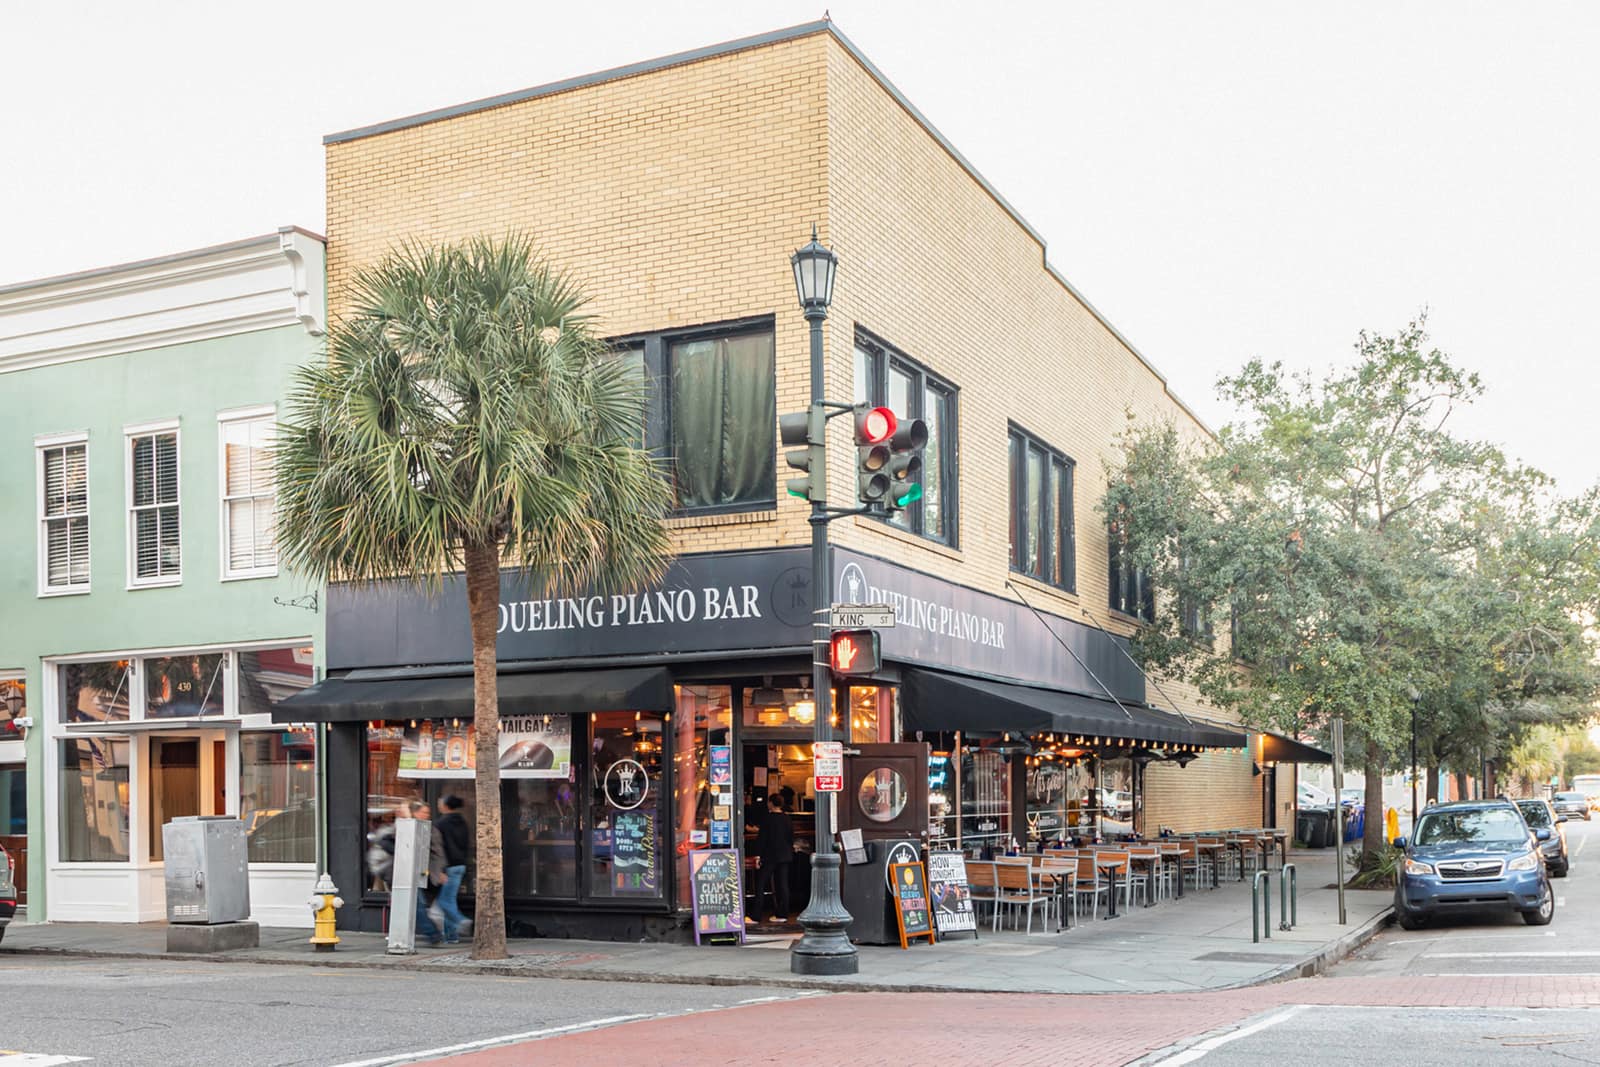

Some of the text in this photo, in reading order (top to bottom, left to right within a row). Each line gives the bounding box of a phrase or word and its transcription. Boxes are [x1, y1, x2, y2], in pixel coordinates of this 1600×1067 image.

[497, 585, 762, 633] DUELING PIANO BAR
[839, 614, 889, 626] KING ST
[939, 605, 979, 643] PIANO
[981, 617, 1006, 649] BAR
[176, 681, 192, 692] 430
[502, 719, 553, 735] TAILGATE
[618, 779, 634, 797] JK
[702, 882, 725, 894] CLAM
[699, 893, 730, 905] STRIPS
